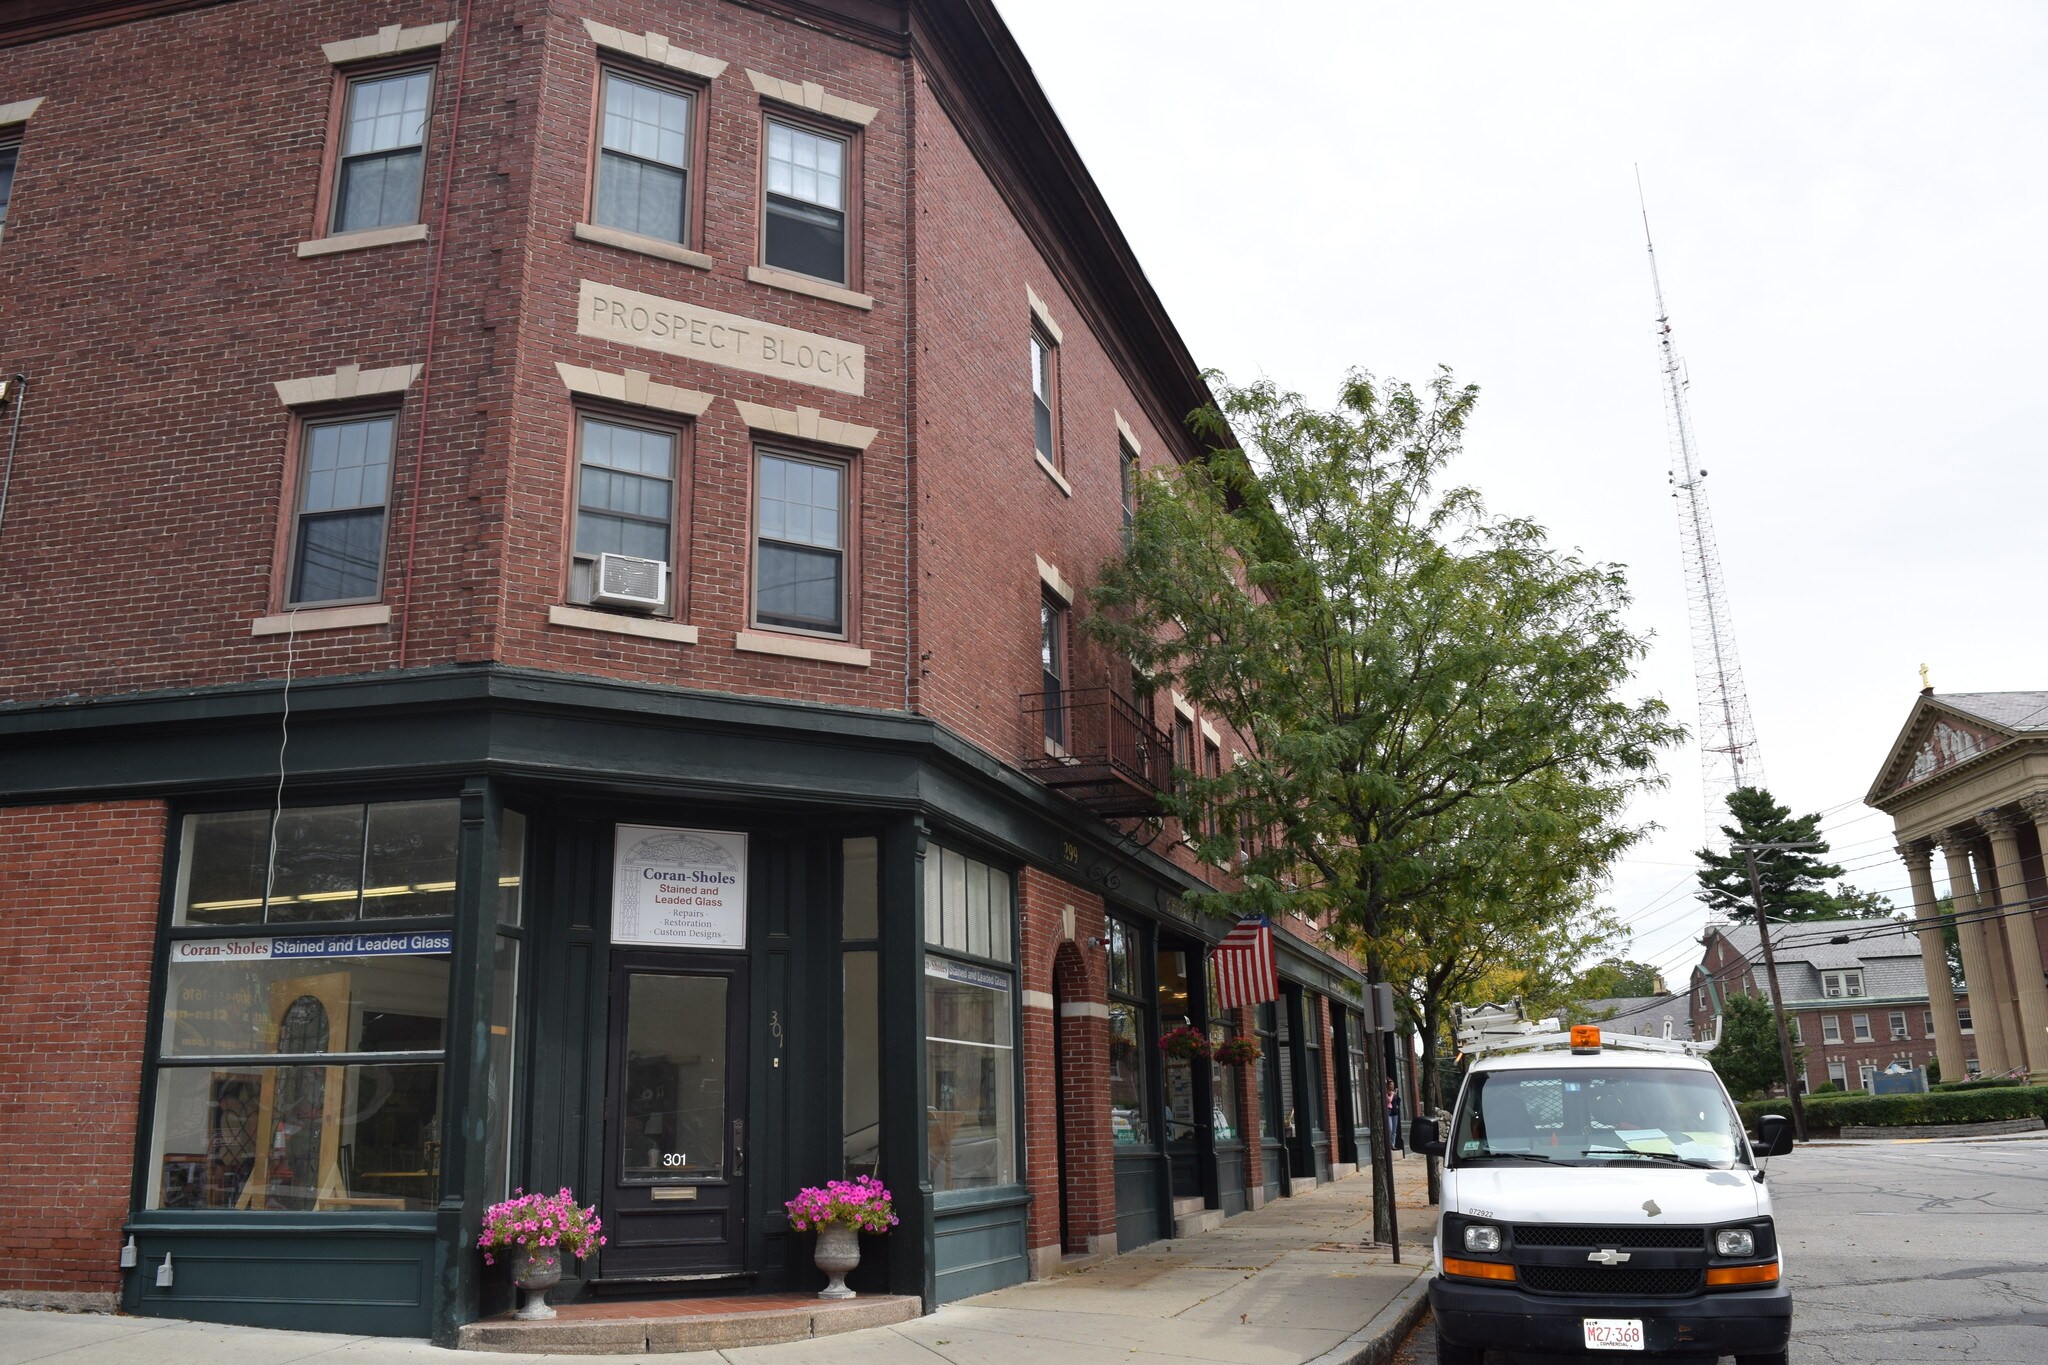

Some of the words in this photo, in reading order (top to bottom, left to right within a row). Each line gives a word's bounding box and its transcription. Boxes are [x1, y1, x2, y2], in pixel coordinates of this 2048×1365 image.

[592, 296, 750, 354] PROSPECT
[762, 335, 855, 381] BLOCK
[1063, 841, 1078, 864] 299
[643, 867, 736, 885] Coran-Sholes
[659, 884, 698, 895] Stained
[700, 886, 719, 896] and
[655, 895, 692, 906] Leaded
[695, 896, 723, 907] Glass
[673, 909, 704, 919] Repairs
[664, 919, 712, 928] Restoration
[653, 928, 687, 937] Custom
[689, 929, 722, 940] Designs
[180, 941, 269, 957] Coran-Sholes
[273, 940, 325, 955] Stained
[327, 938, 353, 953] and
[357, 937, 409, 952] Leaded
[411, 935, 450, 950] Glass
[948, 963, 968, 979] Stained
[968, 970, 977, 981] and
[977, 971, 994, 985] Leaded
[995, 975, 1007, 988] Glass
[769, 1010, 784, 1048] 301
[663, 1153, 687, 1166] 301
